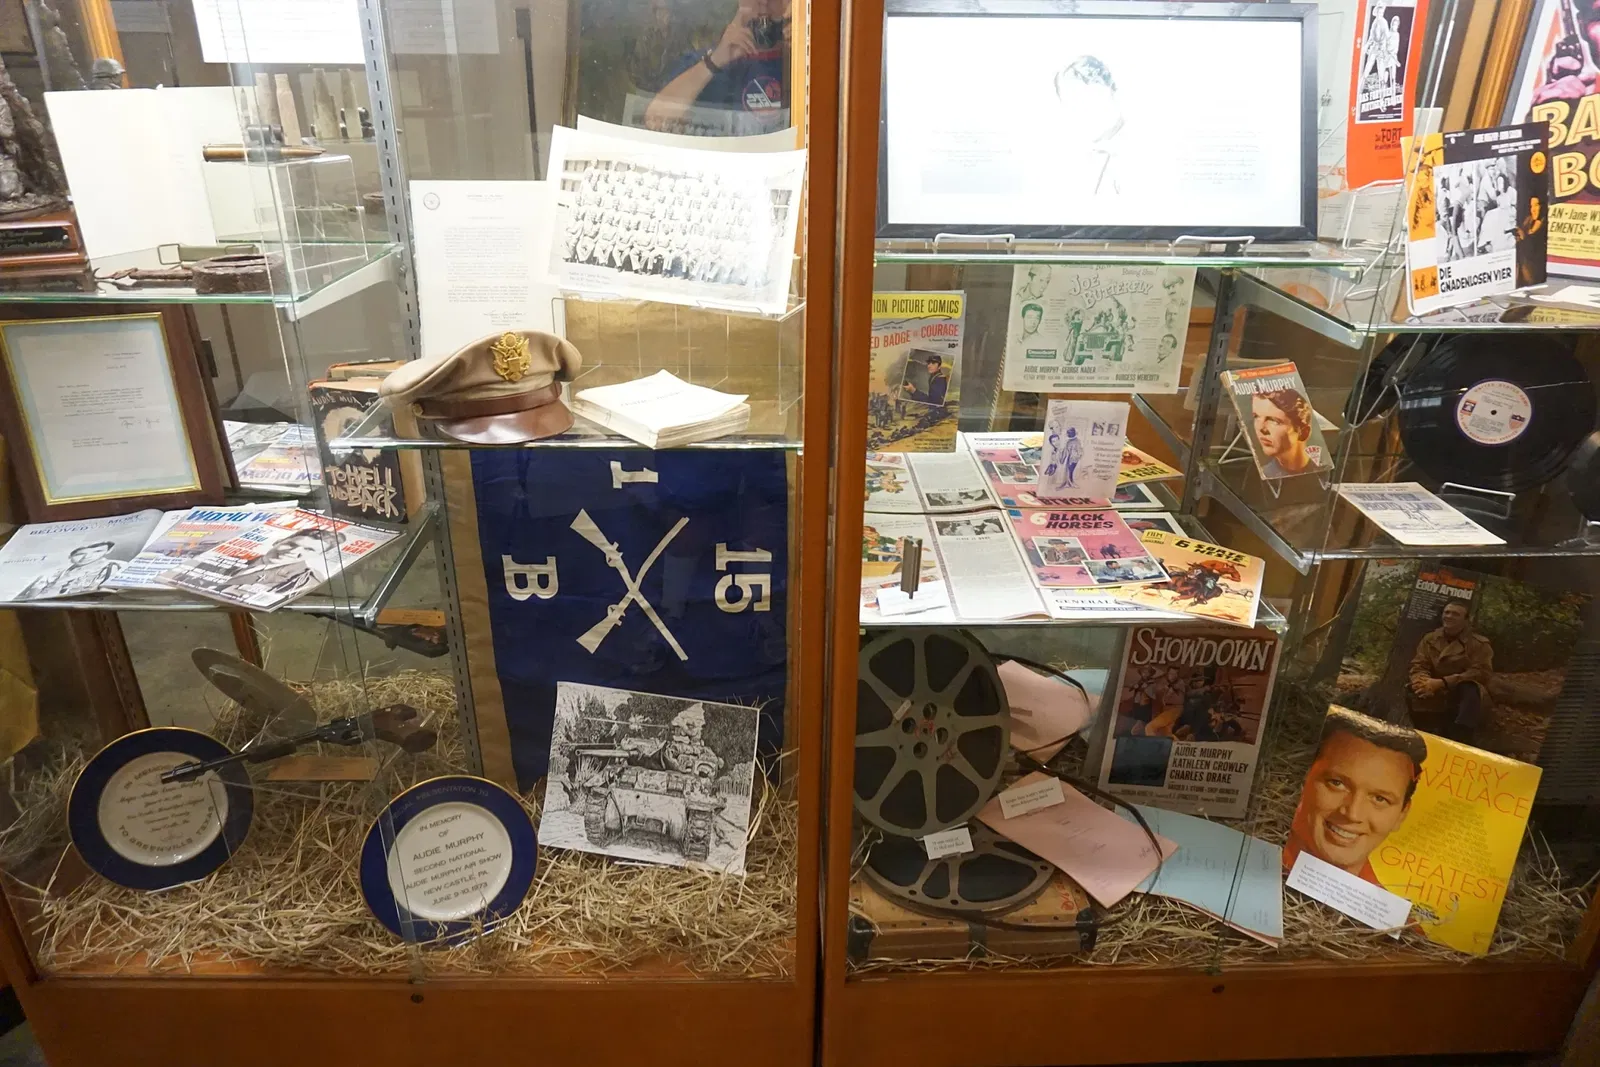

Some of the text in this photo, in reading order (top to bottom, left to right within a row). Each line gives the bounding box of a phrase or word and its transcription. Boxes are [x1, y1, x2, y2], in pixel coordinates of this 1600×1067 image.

[1568, 208, 1588, 221] Jane
[1549, 221, 1585, 235] EMENTS
[1439, 266, 1452, 280] DIE
[1440, 267, 1512, 293] GNADENLOSEN VIER
[1069, 273, 1101, 296] JOE
[1081, 280, 1154, 310] BUTTERFLY
[892, 299, 925, 314] PICTURE
[927, 300, 960, 314] COMICS
[883, 329, 912, 348] BADGE
[920, 323, 960, 339] COURAGE
[1039, 365, 1059, 374] MURPHY
[1061, 366, 1079, 374] GEORGE
[1080, 366, 1096, 374] NADER
[1115, 373, 1136, 381] BURGESS
[1137, 373, 1160, 382] MEREDITH
[1233, 376, 1297, 395] AUDIE MURPHY
[346, 485, 399, 519] BACK
[186, 510, 253, 522] World
[1029, 512, 1105, 526] 6 BLACK
[1045, 521, 1114, 529] HORSES
[29, 526, 89, 536] BELOVED
[341, 544, 368, 555] WAR
[350, 539, 376, 549] SEA
[1175, 539, 1191, 548] 6
[501, 554, 559, 602] B
[714, 542, 773, 614] 15
[1415, 579, 1439, 593] Eddy
[1439, 584, 1473, 601] Arnold
[1131, 627, 1274, 672] SHOWDOWN
[1174, 746, 1234, 760] AUDIE MURPHY
[1172, 758, 1249, 774] KATHLEEN CROWLEY
[1436, 751, 1509, 788] JERRY
[1169, 769, 1232, 784] CHARLES DRAKE
[118, 806, 214, 852] TO GREENVILLE TEXAS
[419, 813, 462, 833] IN MEMORY
[438, 829, 449, 838] OF
[412, 832, 485, 862] AUDIE MURPHY
[413, 846, 487, 876] SECOND NATIONAL
[405, 853, 502, 891] AUDIE MURPHY AIR SHOW
[1379, 845, 1505, 903] GREATEST
[423, 885, 443, 896] NEW
[432, 893, 453, 906] JUNE
[471, 881, 489, 893] 1973
[1404, 879, 1461, 912] HITS
